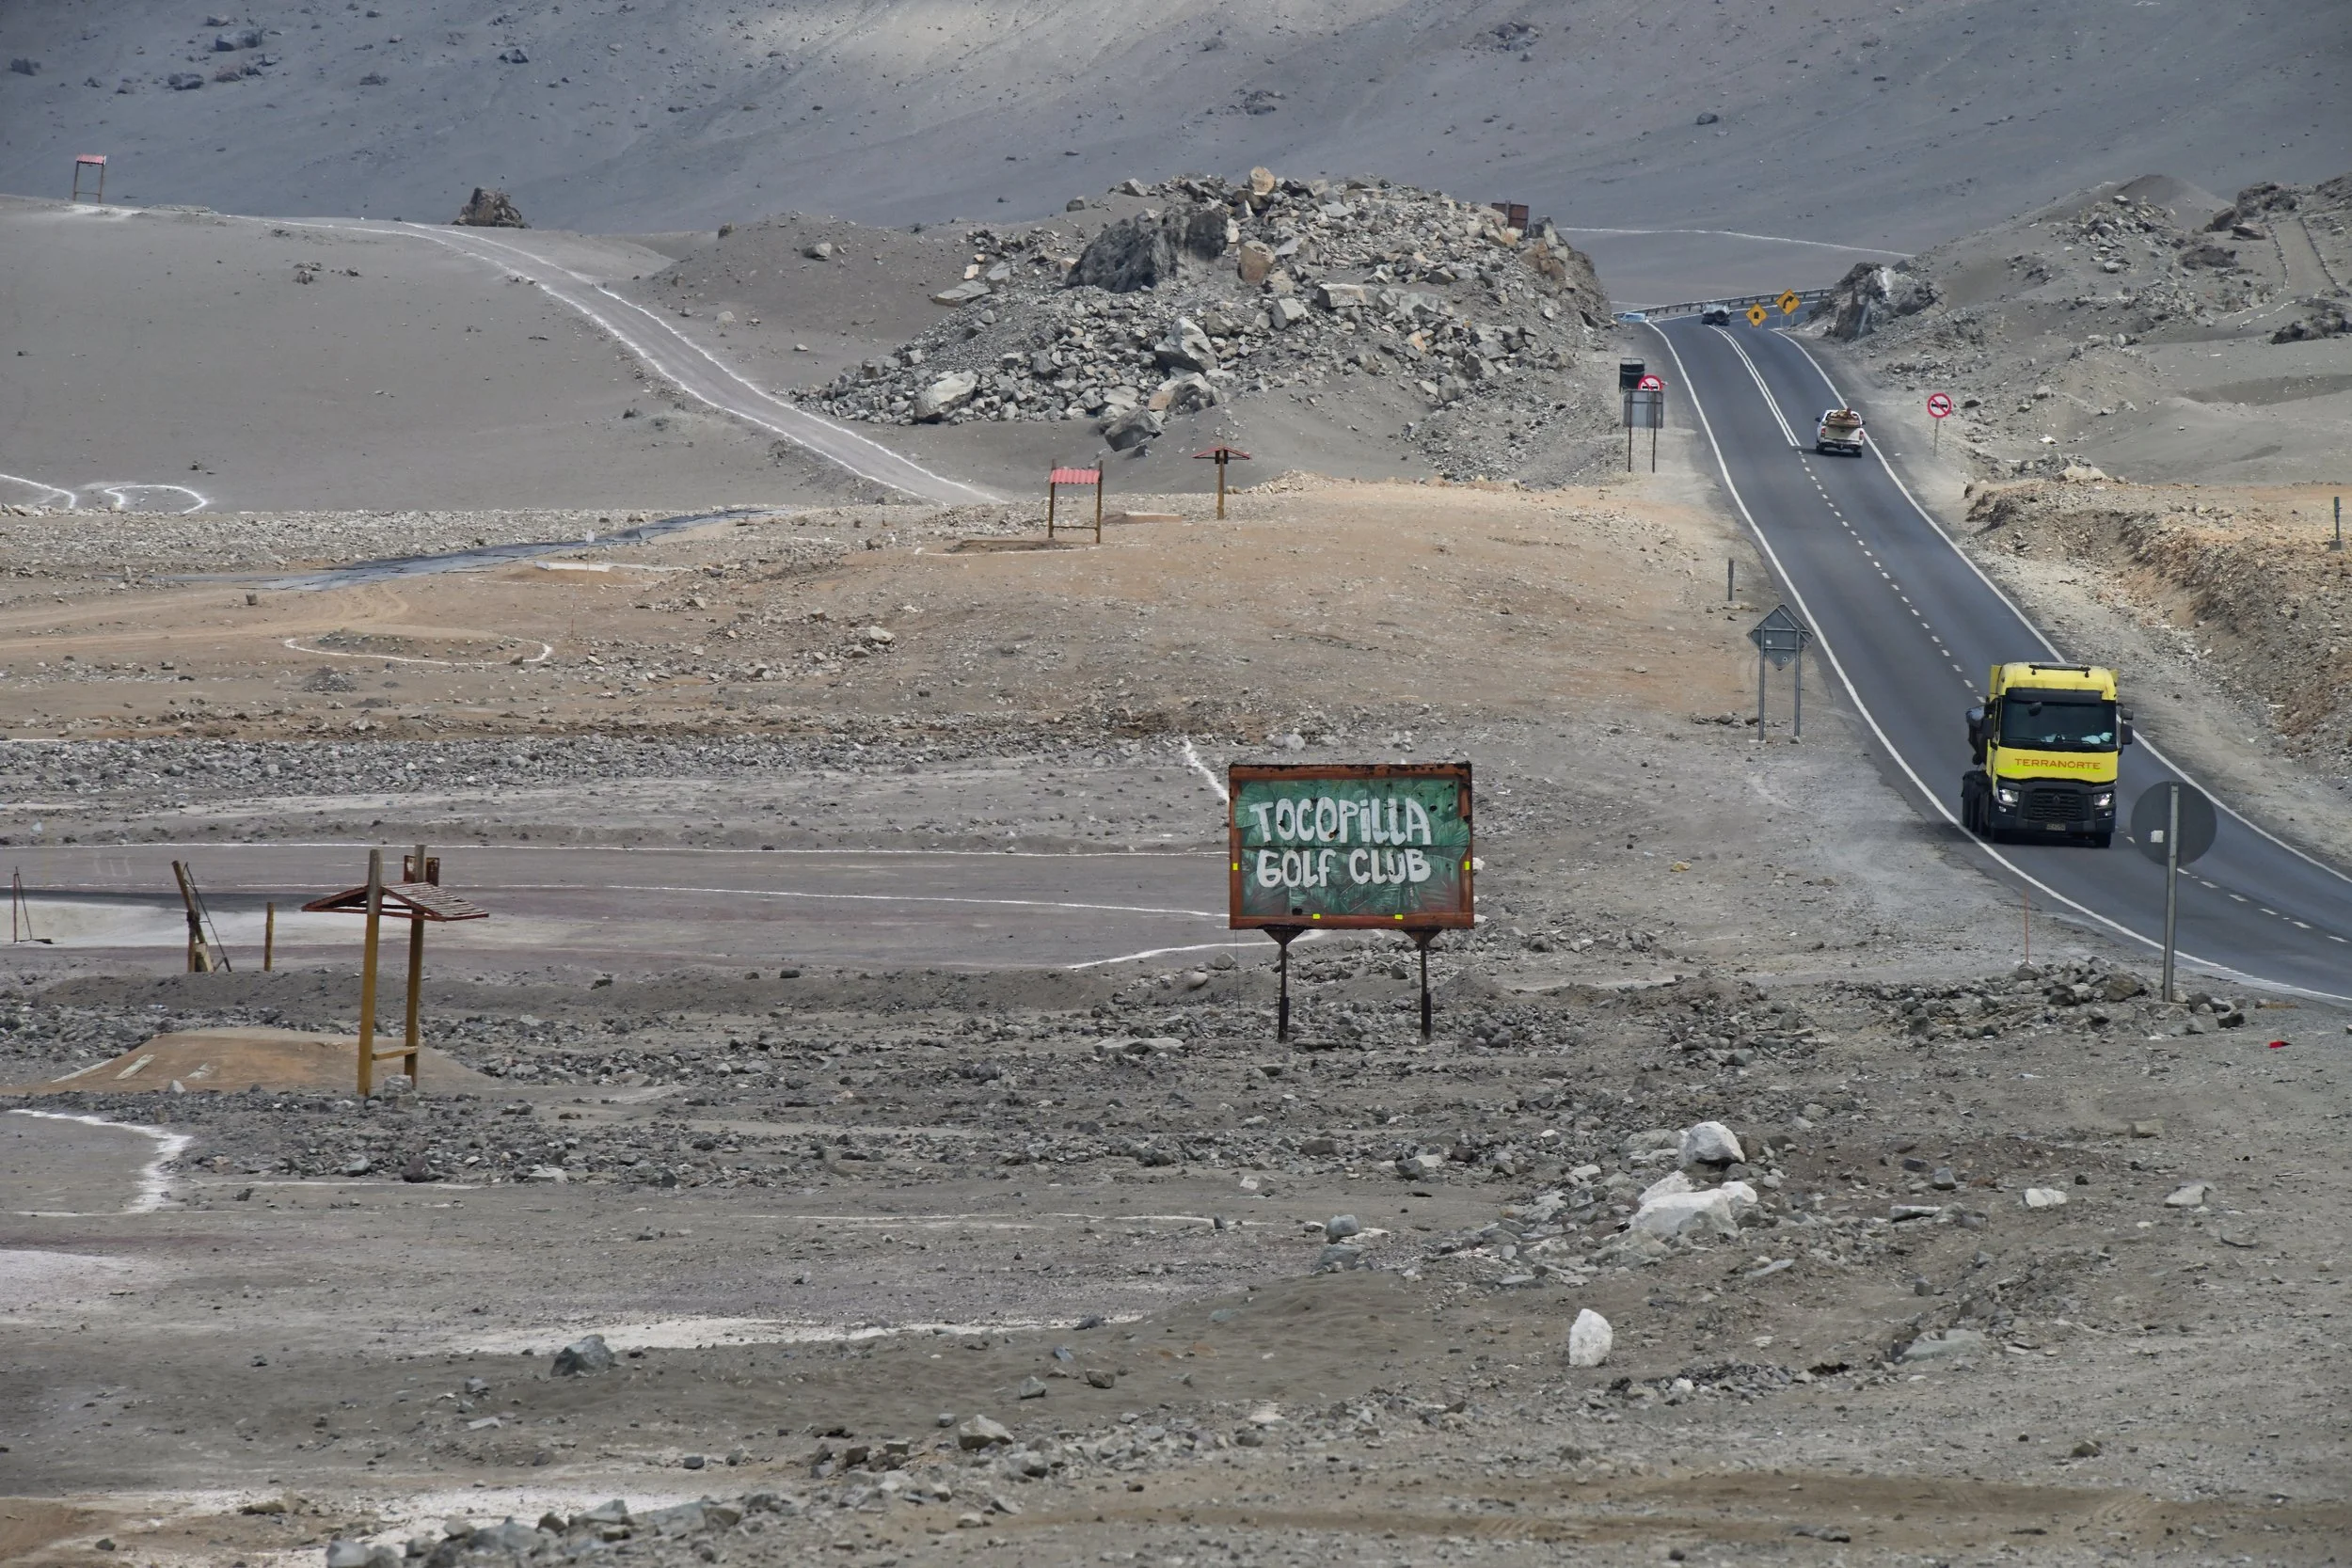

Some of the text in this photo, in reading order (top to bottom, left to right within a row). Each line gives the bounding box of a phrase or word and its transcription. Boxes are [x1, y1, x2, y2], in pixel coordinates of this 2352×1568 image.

[2014, 758, 2101, 770] TERRANORTE
[1248, 797, 1432, 846] TOCOPILLA
[1256, 847, 1432, 888] GOLF CLUB
